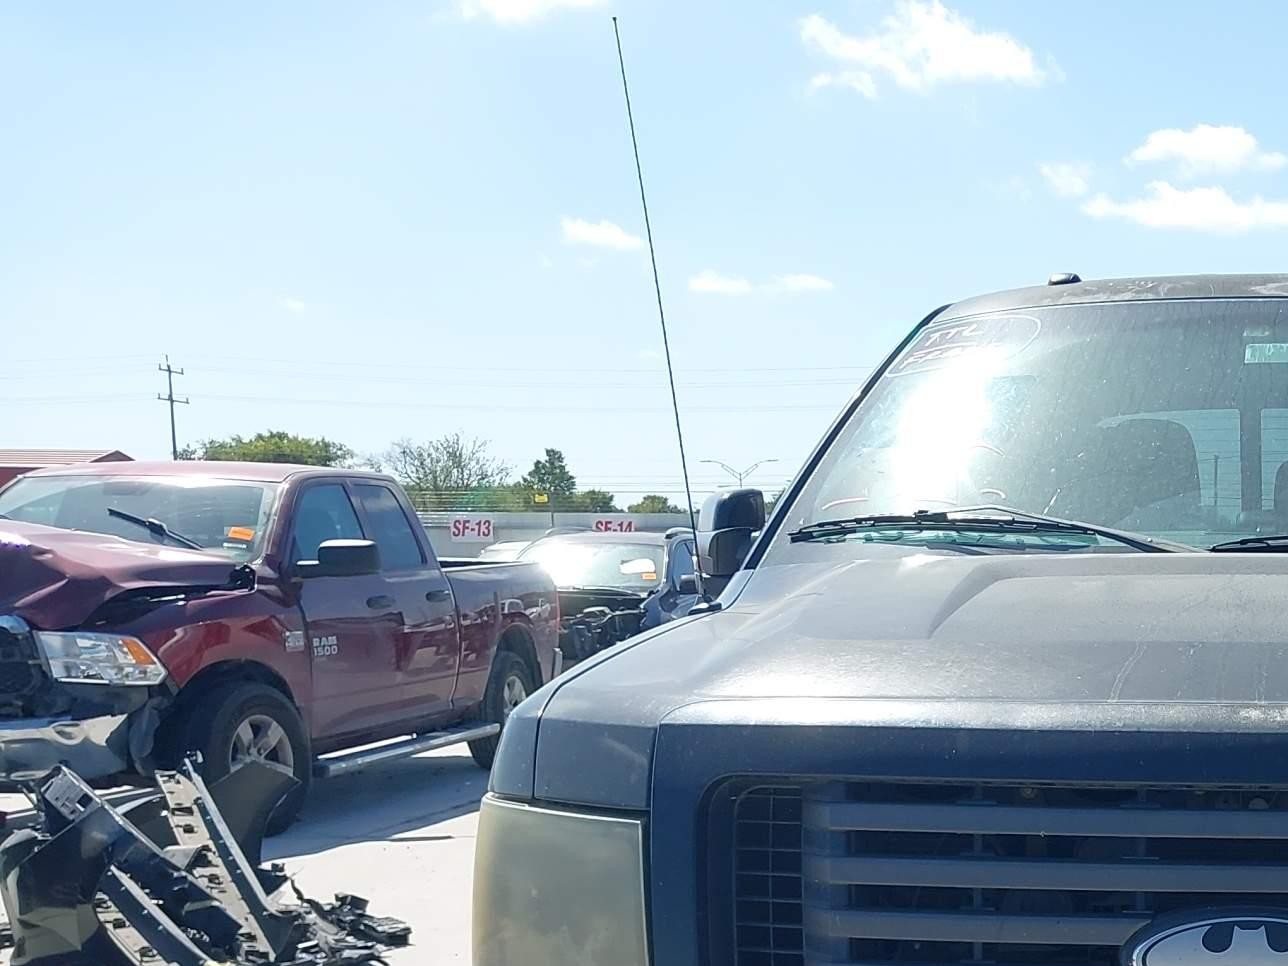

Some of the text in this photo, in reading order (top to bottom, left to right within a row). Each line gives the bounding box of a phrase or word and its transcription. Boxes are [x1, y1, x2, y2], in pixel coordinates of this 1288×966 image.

[451, 519, 492, 537] SF-13
[594, 519, 634, 532] SF-14
[312, 635, 338, 647] RAM
[313, 645, 338, 657] 1500
